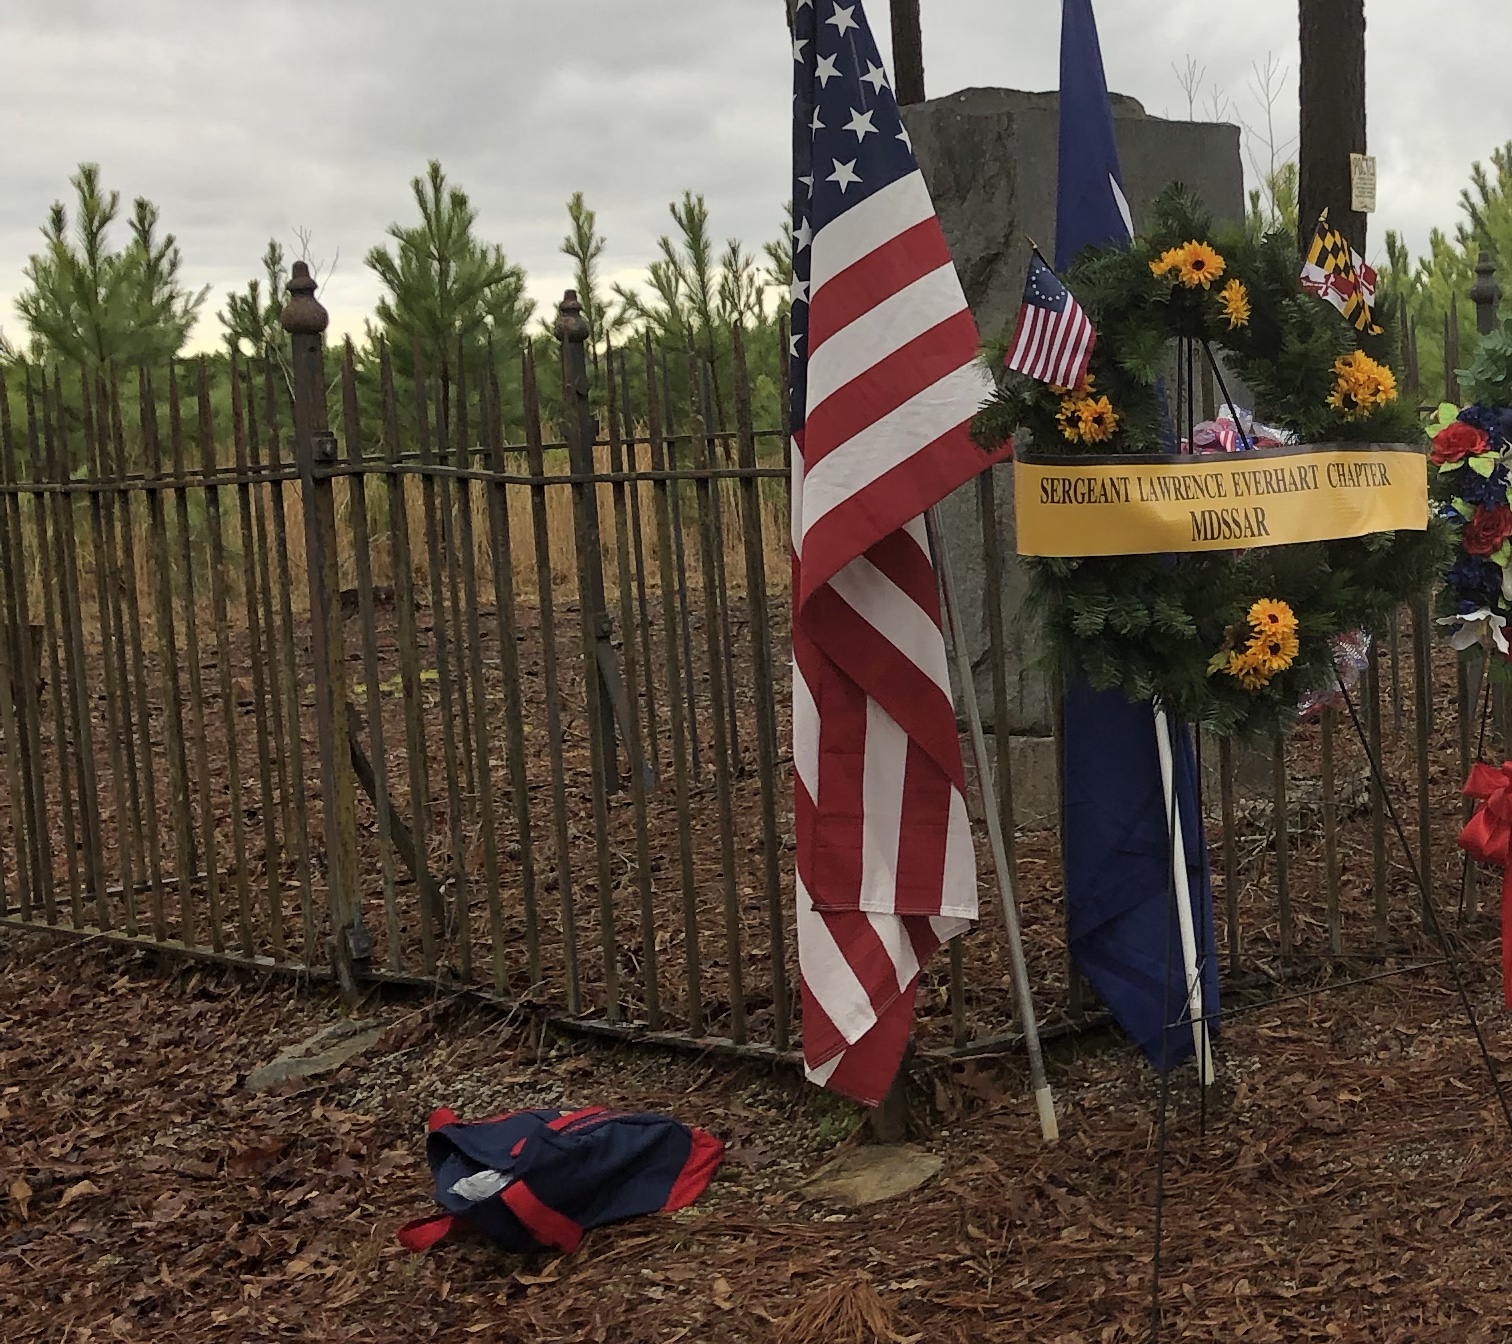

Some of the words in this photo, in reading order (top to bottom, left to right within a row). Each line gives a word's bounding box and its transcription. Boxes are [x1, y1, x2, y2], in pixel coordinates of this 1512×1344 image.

[1039, 476, 1131, 504] SERGEANT
[1137, 473, 1228, 502] LAWRENCE
[1234, 465, 1320, 497] EVERHART
[1326, 462, 1393, 488] CHAPTER
[1189, 508, 1271, 542] MDSSAR
